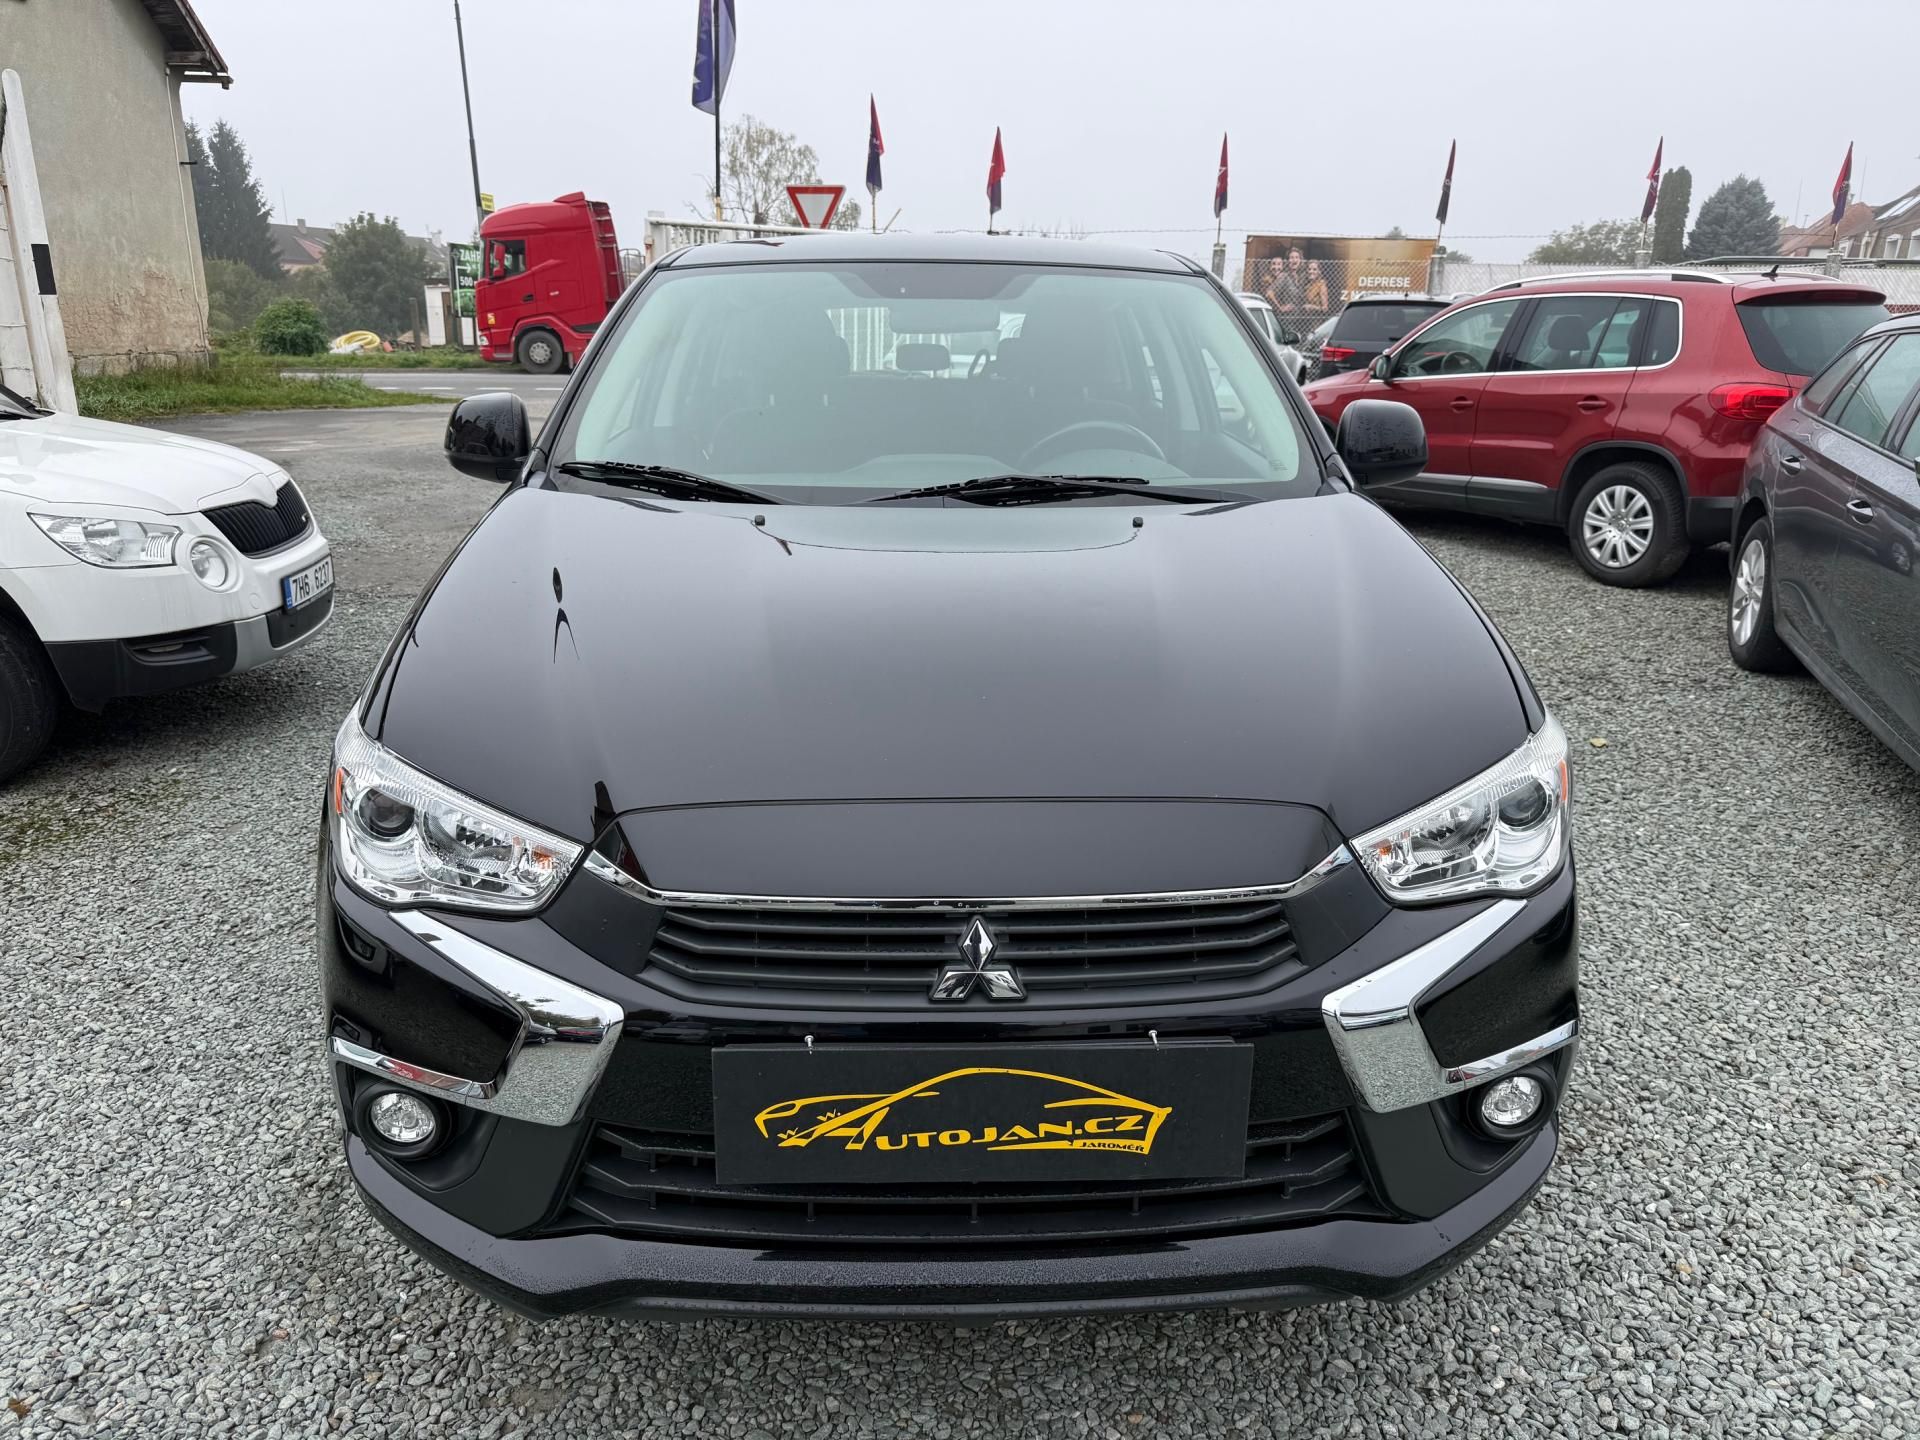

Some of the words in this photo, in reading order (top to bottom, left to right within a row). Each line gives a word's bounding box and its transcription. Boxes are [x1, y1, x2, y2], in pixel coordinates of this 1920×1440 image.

[460, 276, 473, 287] 500
[1358, 276, 1411, 288] DEPRESE
[292, 573, 311, 603] 7H6
[314, 561, 330, 589] 6237
